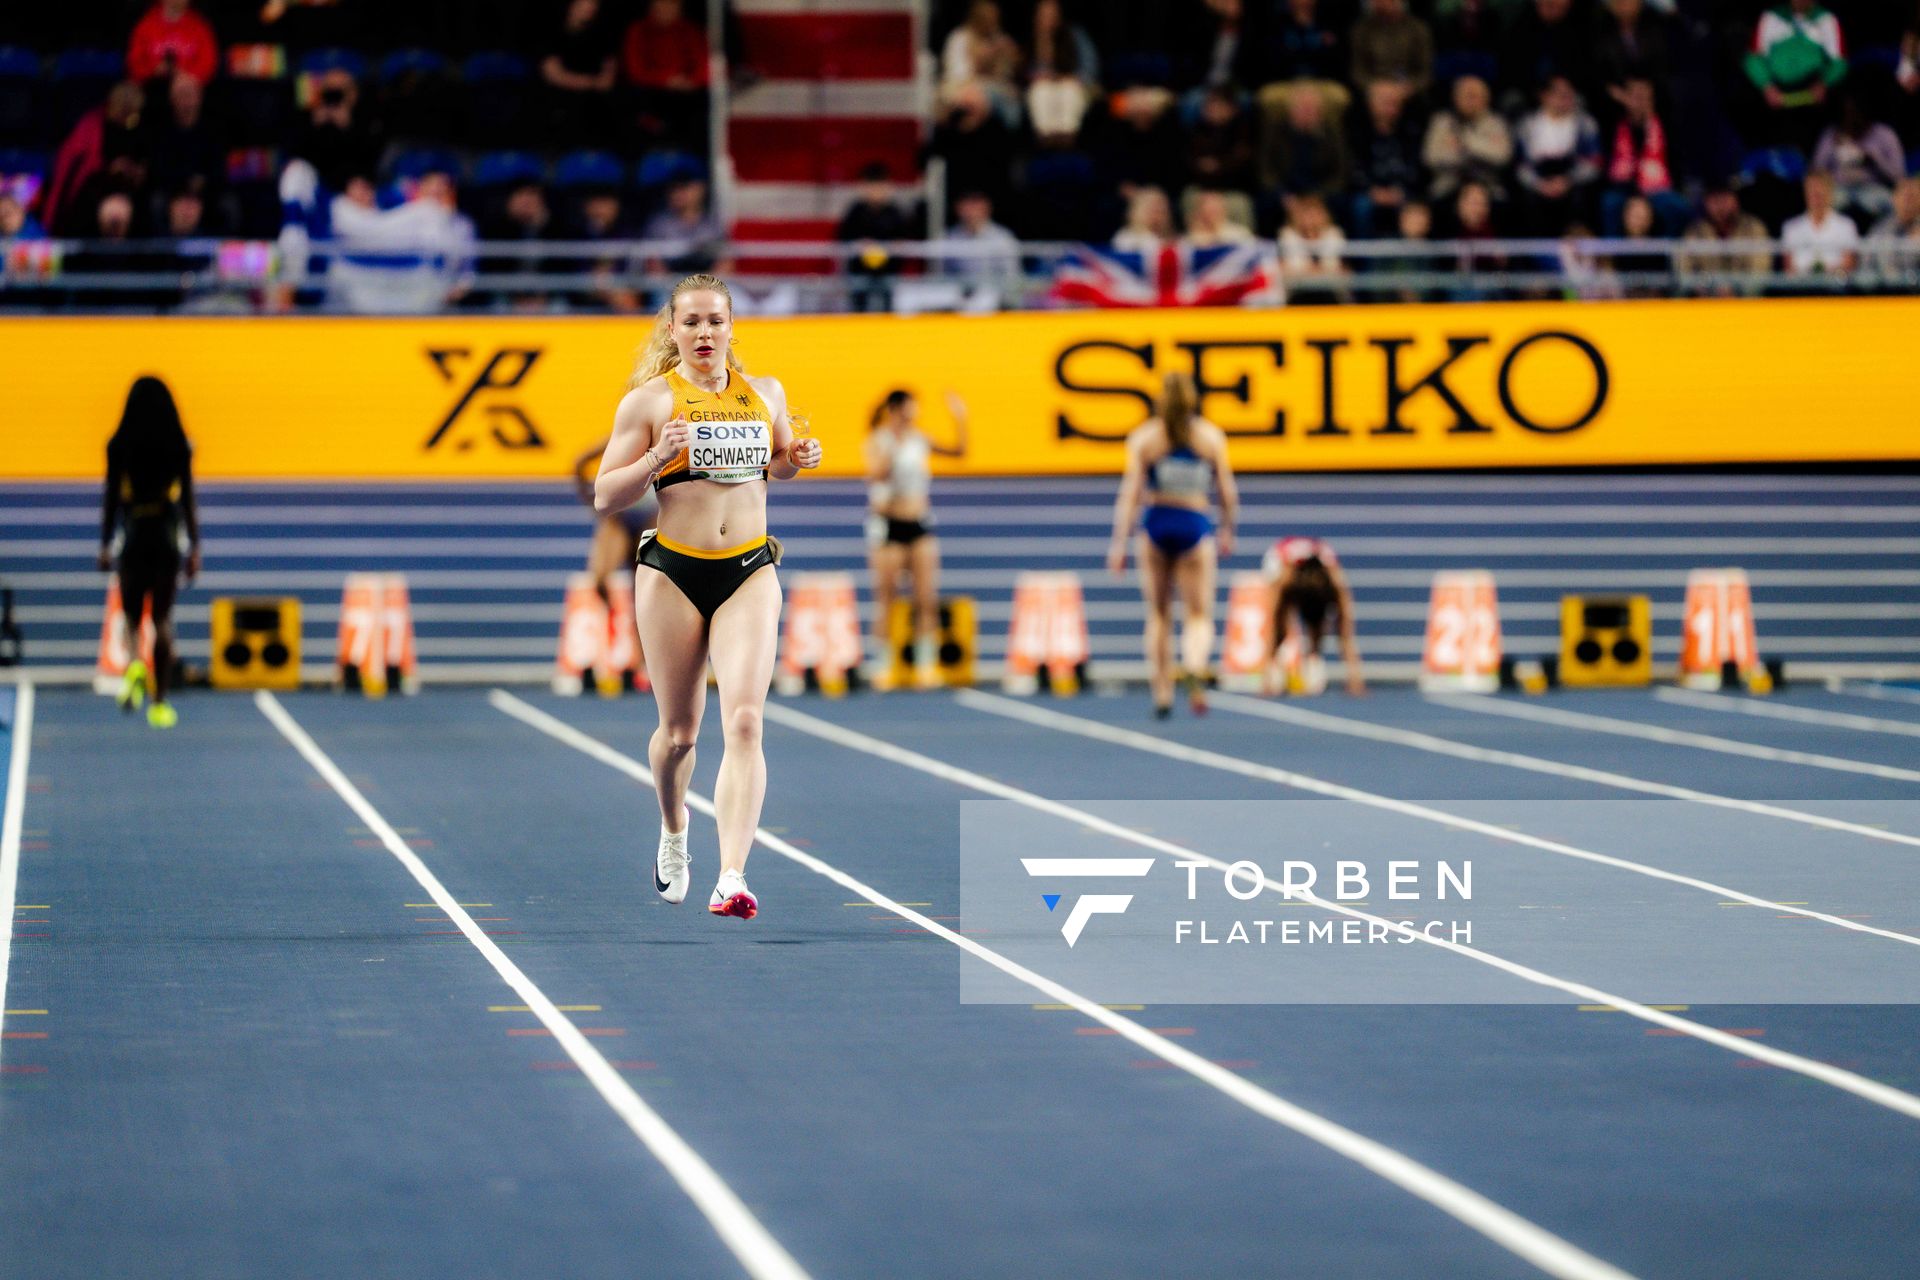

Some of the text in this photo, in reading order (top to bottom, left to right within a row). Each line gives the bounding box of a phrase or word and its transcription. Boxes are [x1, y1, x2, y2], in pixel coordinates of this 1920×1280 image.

[1055, 331, 1609, 442] SEIKO
[690, 410, 762, 422] GERMANY
[697, 426, 763, 440] SONY
[693, 447, 768, 467] SCHWARTZ
[1231, 606, 1266, 666] 3
[1432, 608, 1465, 666] 2
[1691, 608, 1713, 665] 1
